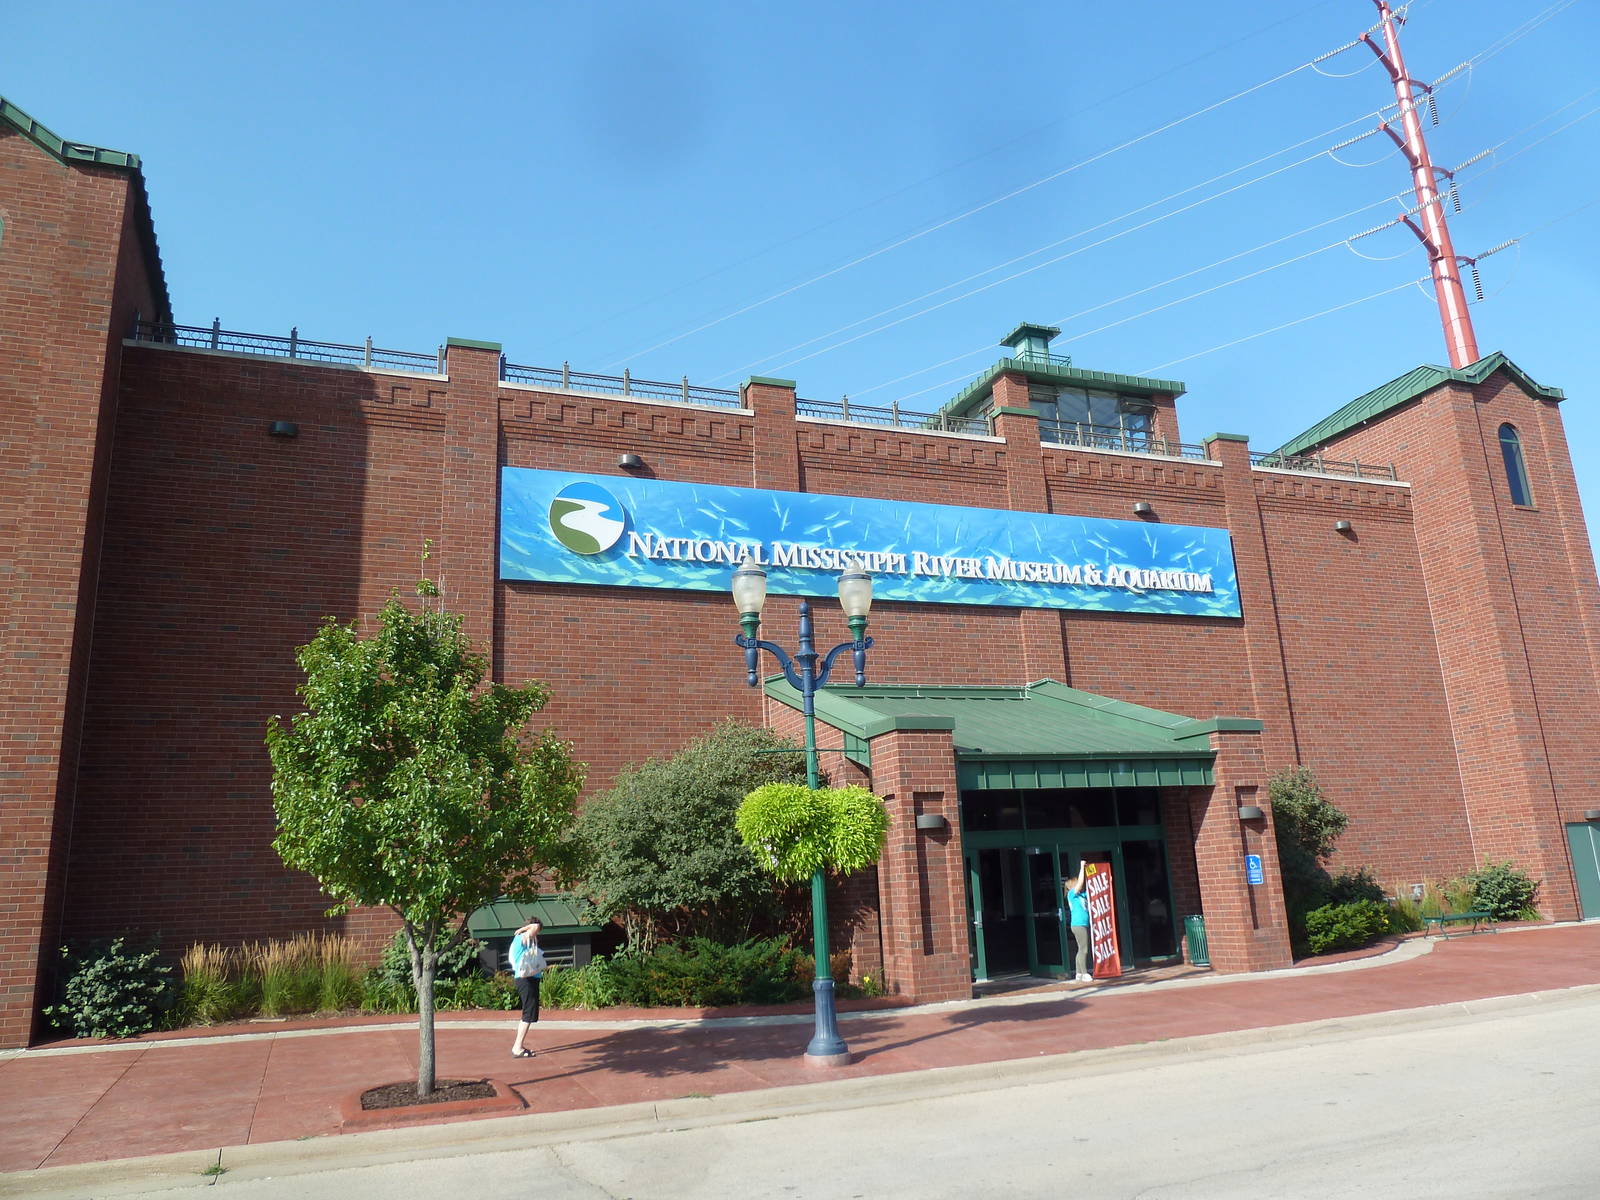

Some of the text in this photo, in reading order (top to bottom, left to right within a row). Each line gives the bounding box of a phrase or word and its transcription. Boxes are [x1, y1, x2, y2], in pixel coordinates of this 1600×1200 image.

[628, 531, 1213, 594] NATIONAL MISSISSIPPI RIVER MUSEUM & AQUARIUM
[1088, 872, 1109, 896] SALE
[1091, 895, 1110, 918] SALE
[1093, 917, 1112, 940] SALE
[1095, 939, 1115, 963] SALE
